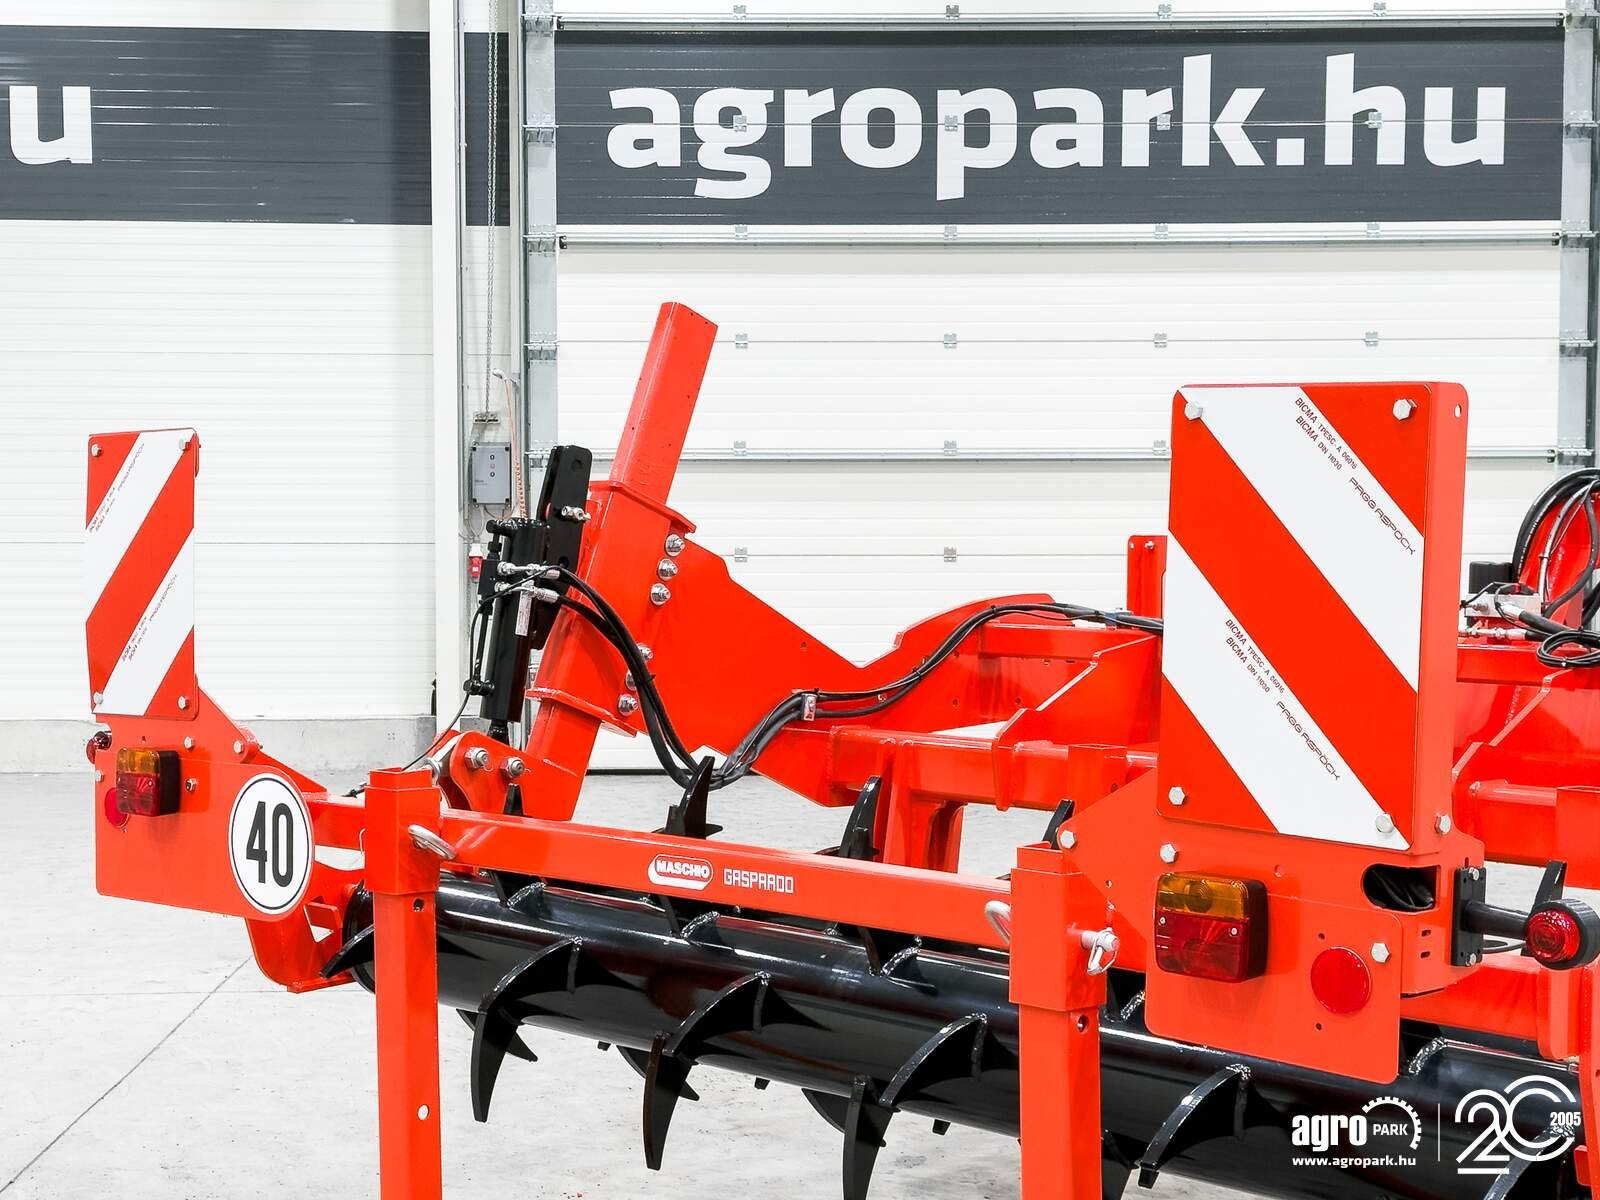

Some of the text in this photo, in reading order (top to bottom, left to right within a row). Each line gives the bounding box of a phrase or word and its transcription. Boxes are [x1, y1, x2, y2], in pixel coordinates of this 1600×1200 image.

[608, 54, 1505, 200] agropark.hu
[1295, 398, 1317, 423] BICMA
[1296, 416, 1318, 441] BICMA
[1226, 619, 1246, 645] BICMA
[1226, 637, 1247, 663] BICMA
[246, 801, 294, 888] 40
[656, 859, 711, 879] MASCHIO
